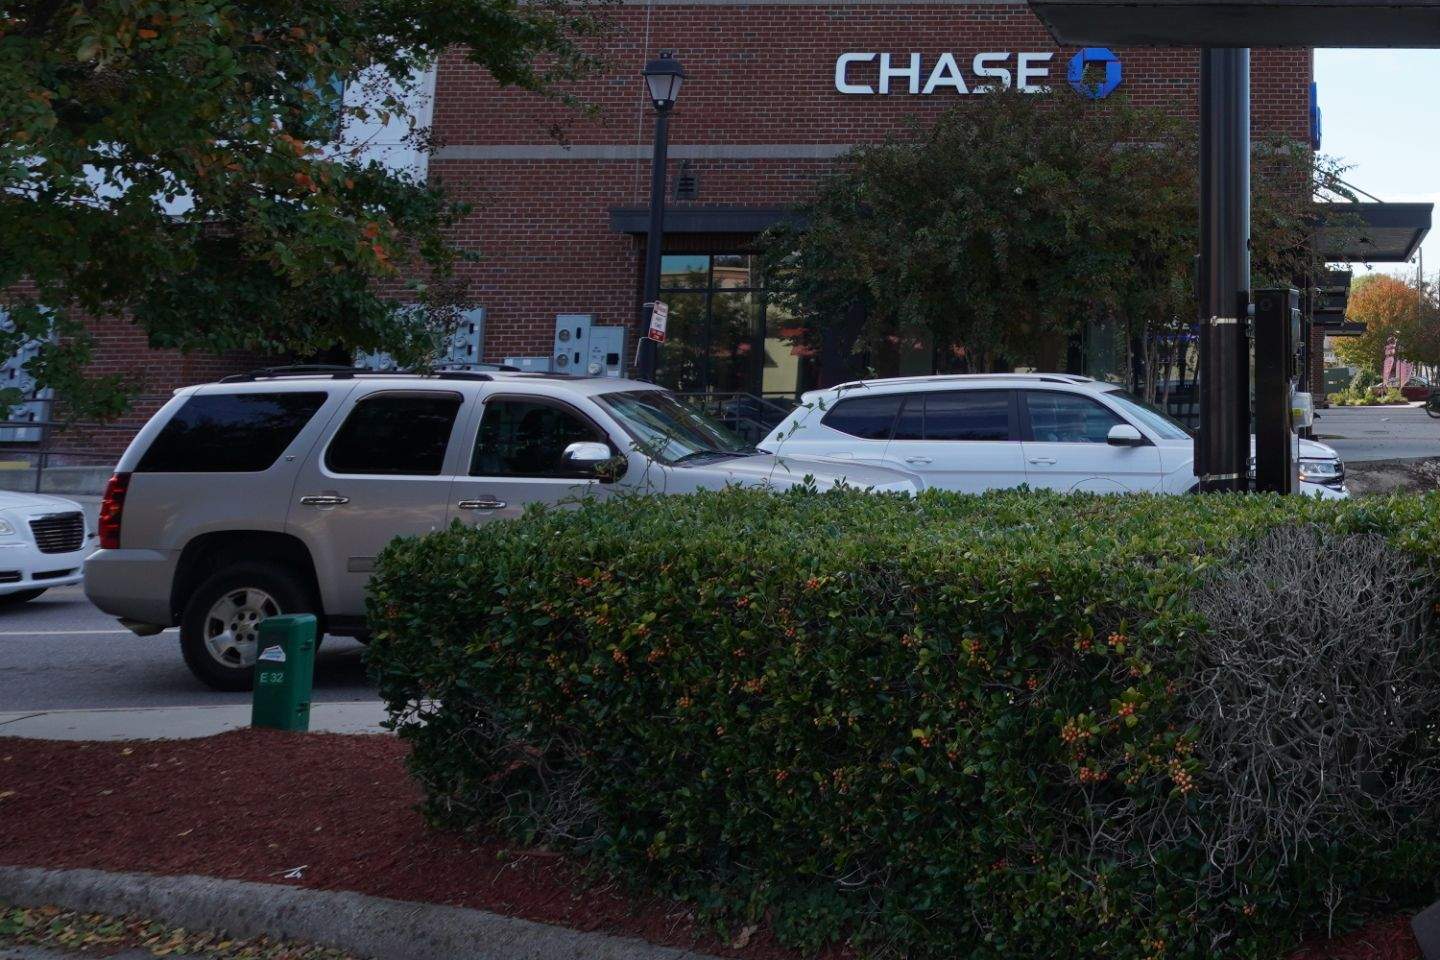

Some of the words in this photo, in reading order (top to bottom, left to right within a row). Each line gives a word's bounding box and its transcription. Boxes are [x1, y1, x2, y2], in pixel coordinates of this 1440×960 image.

[834, 52, 1054, 94] CHASE
[260, 672, 269, 683] E
[271, 672, 284, 683] 32
